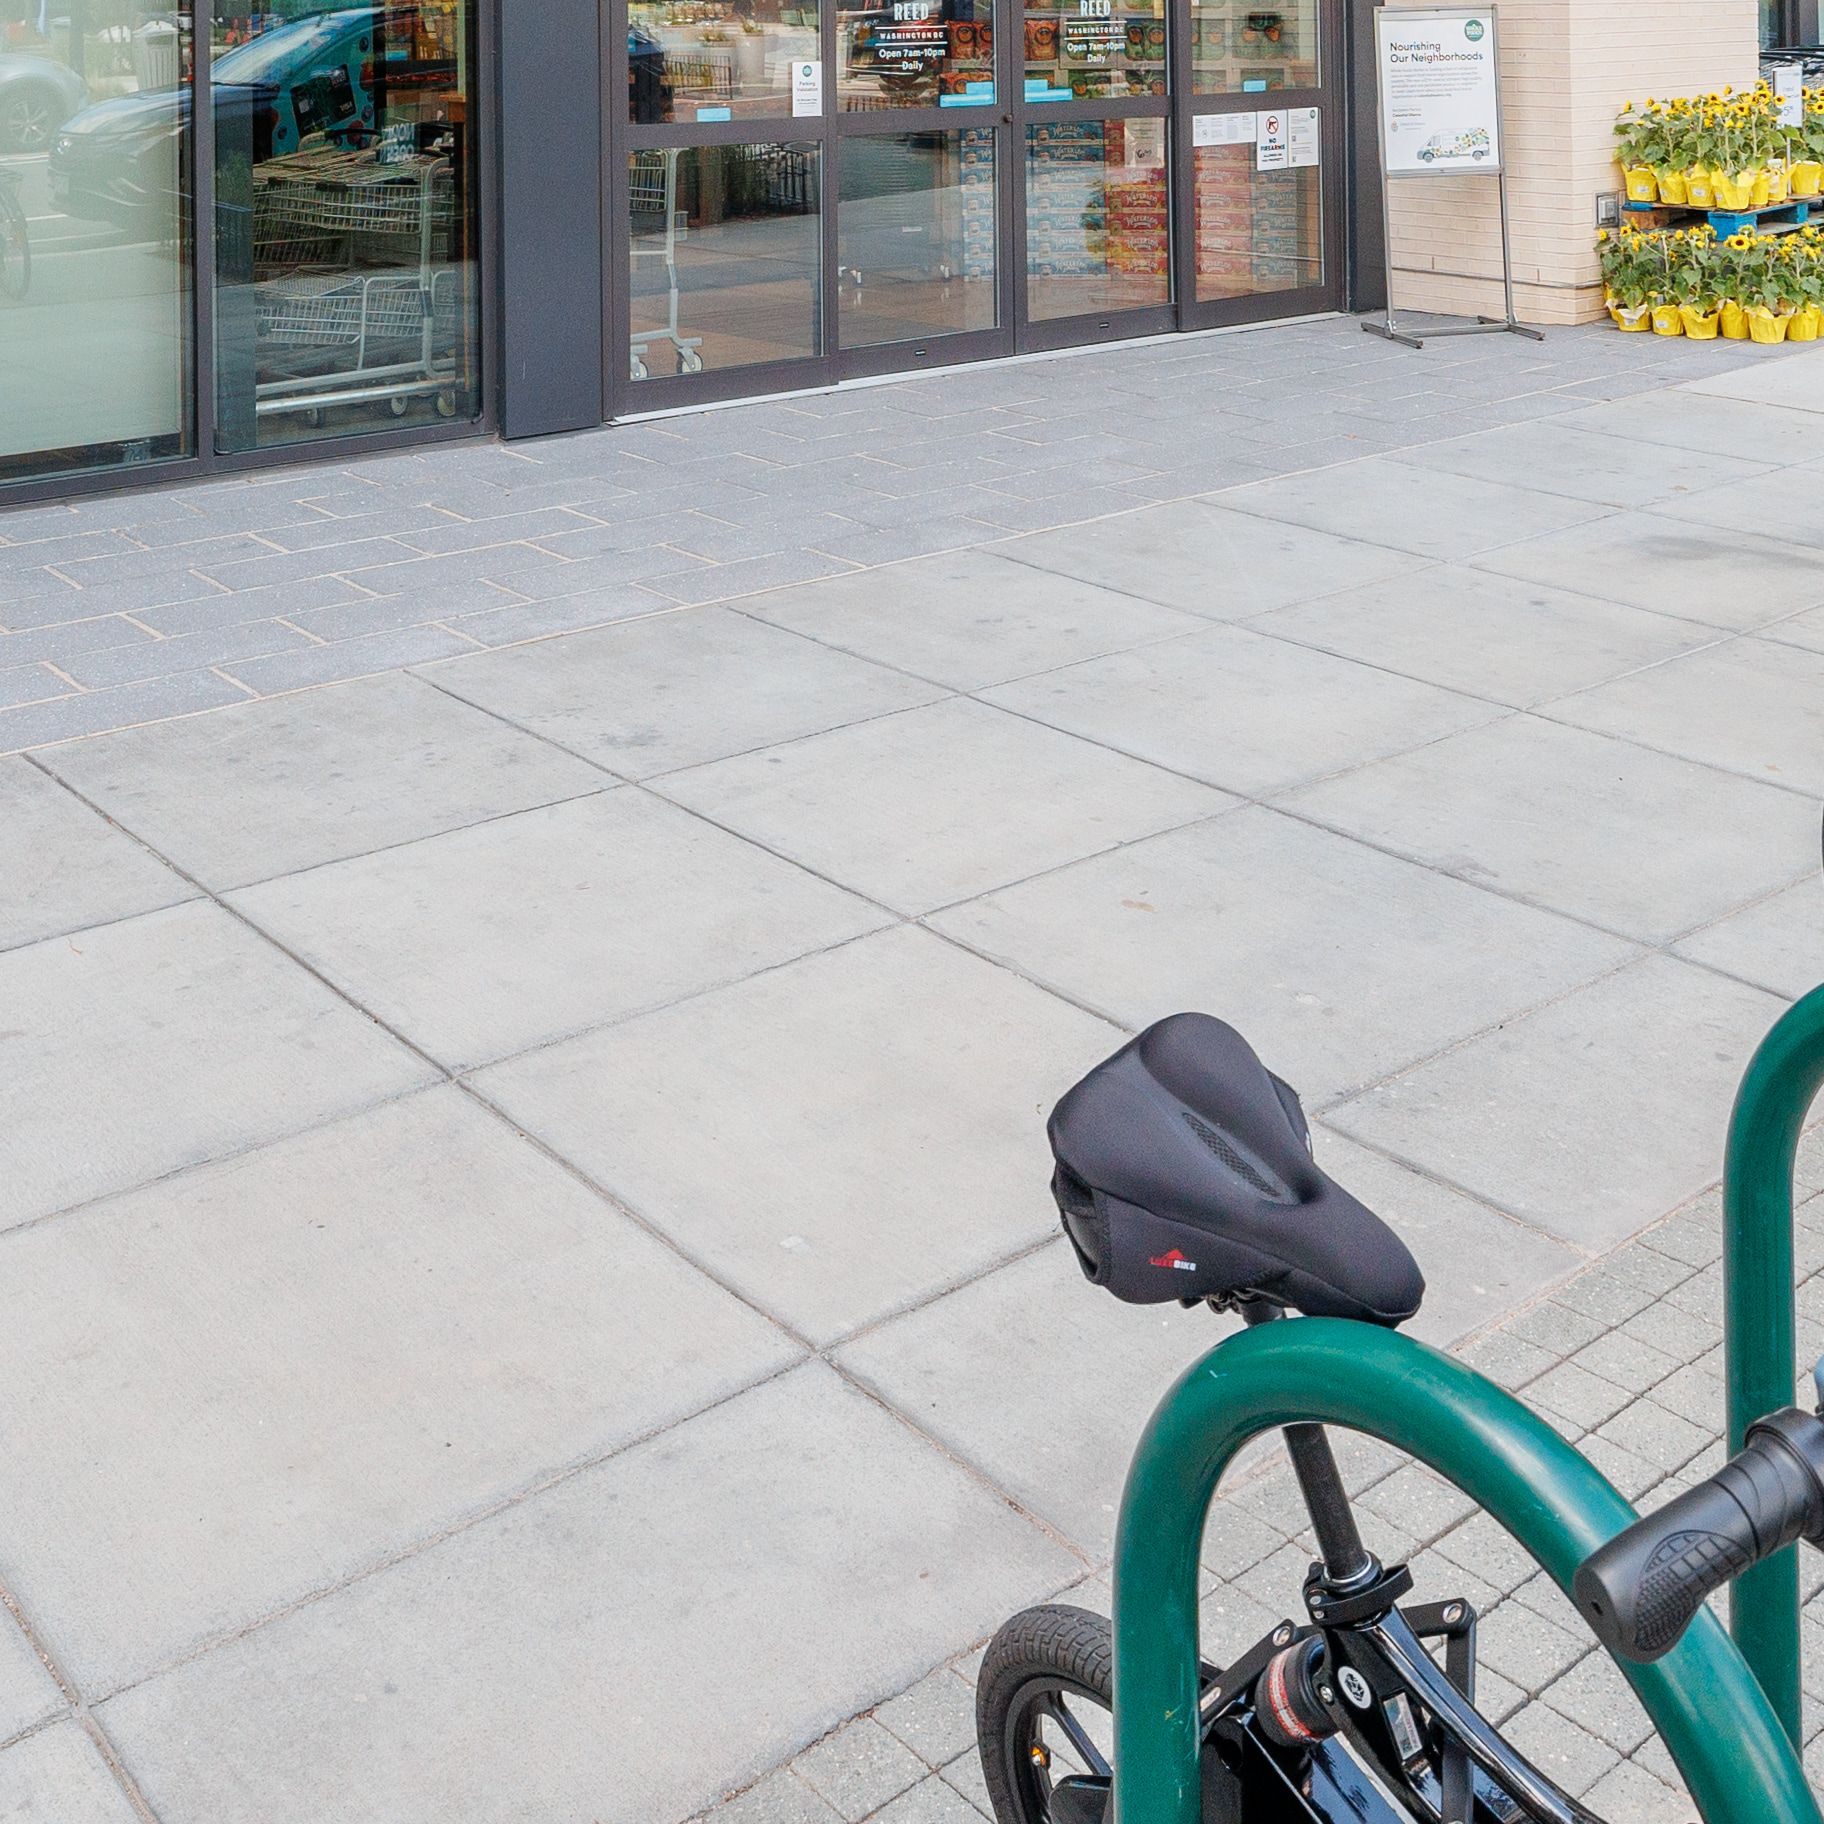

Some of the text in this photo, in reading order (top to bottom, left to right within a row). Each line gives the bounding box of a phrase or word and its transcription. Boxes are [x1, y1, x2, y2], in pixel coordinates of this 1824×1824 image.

[894, 3, 929, 21] REED
[1080, 0, 1111, 17] REED
[879, 31, 931, 40] WASHINGTON
[1067, 42, 1087, 53] Open
[1390, 40, 1441, 53] Nourishing
[879, 48, 946, 59] Open 7am-10pm
[1087, 53, 1106, 63] Daily
[1390, 52, 1483, 64] Our Neighborhoods
[902, 60, 924, 71] Daily
